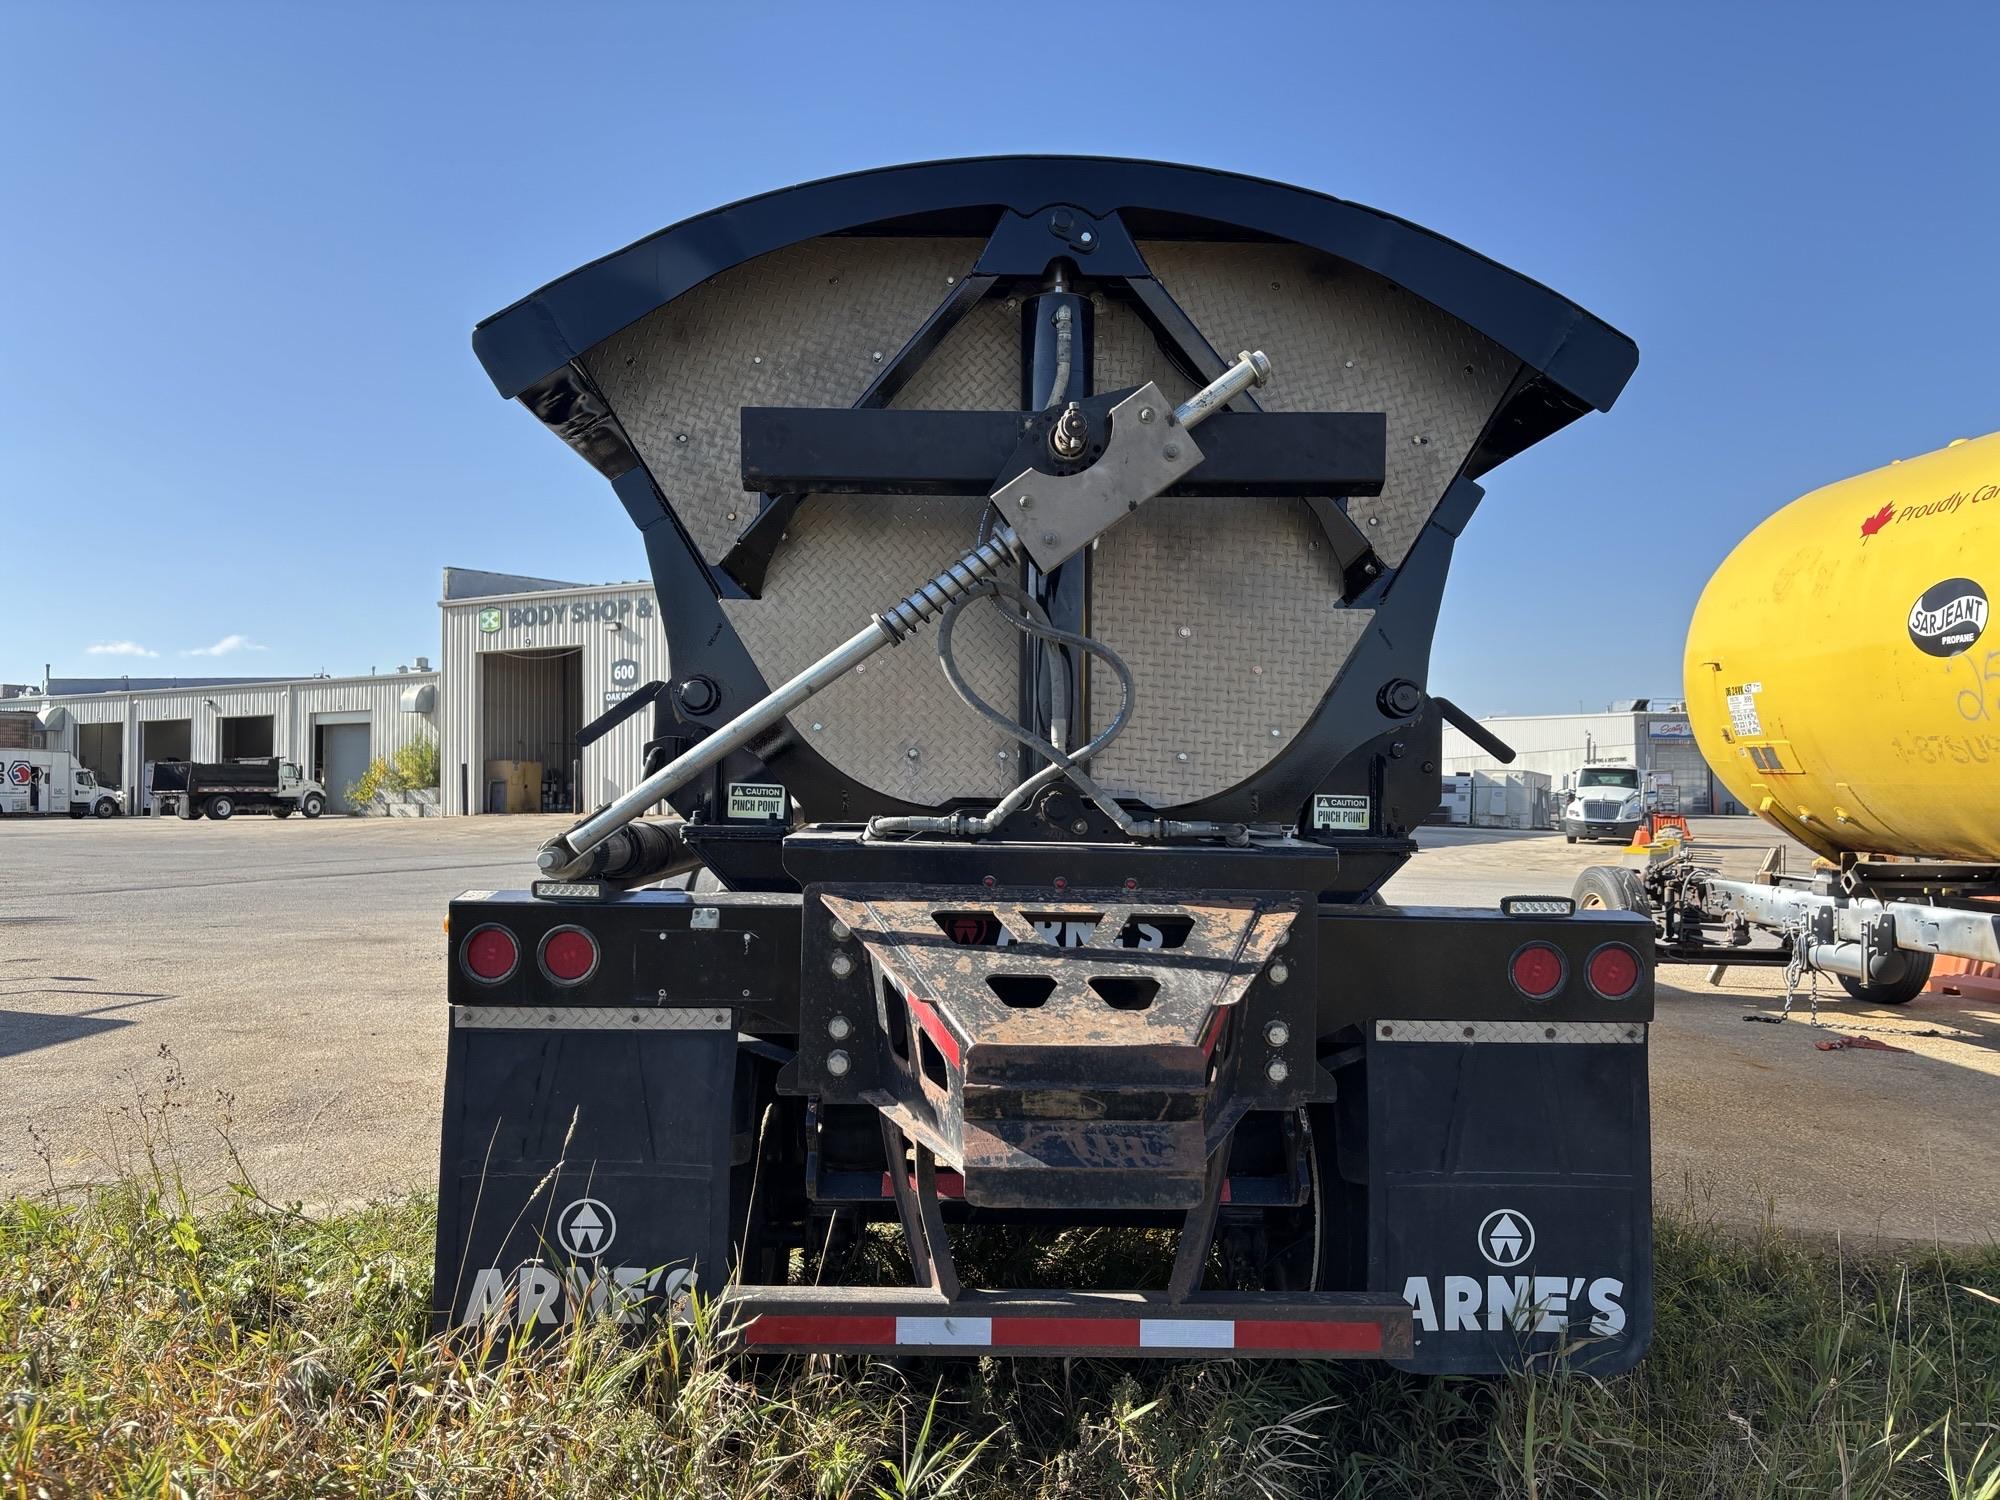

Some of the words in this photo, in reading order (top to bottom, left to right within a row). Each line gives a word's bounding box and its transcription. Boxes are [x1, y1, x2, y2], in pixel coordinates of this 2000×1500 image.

[1896, 491, 1970, 524] Proudly
[509, 604, 567, 627] BODY
[571, 599, 630, 623] SHOP
[637, 598, 653, 618] &
[1912, 598, 1983, 634] SARJEANT
[525, 638, 531, 648] 9
[1941, 633, 1975, 645] PROPANE
[614, 664, 635, 681] 600
[606, 692, 621, 701] OAK
[745, 788, 780, 796] CAUTION
[732, 799, 756, 812] PINCH
[757, 800, 780, 813] POINT
[1330, 799, 1365, 807] CAUTION
[1318, 810, 1341, 822] PINCH
[1343, 811, 1365, 823] POINT
[1401, 1275, 1626, 1337] ARNE'S
